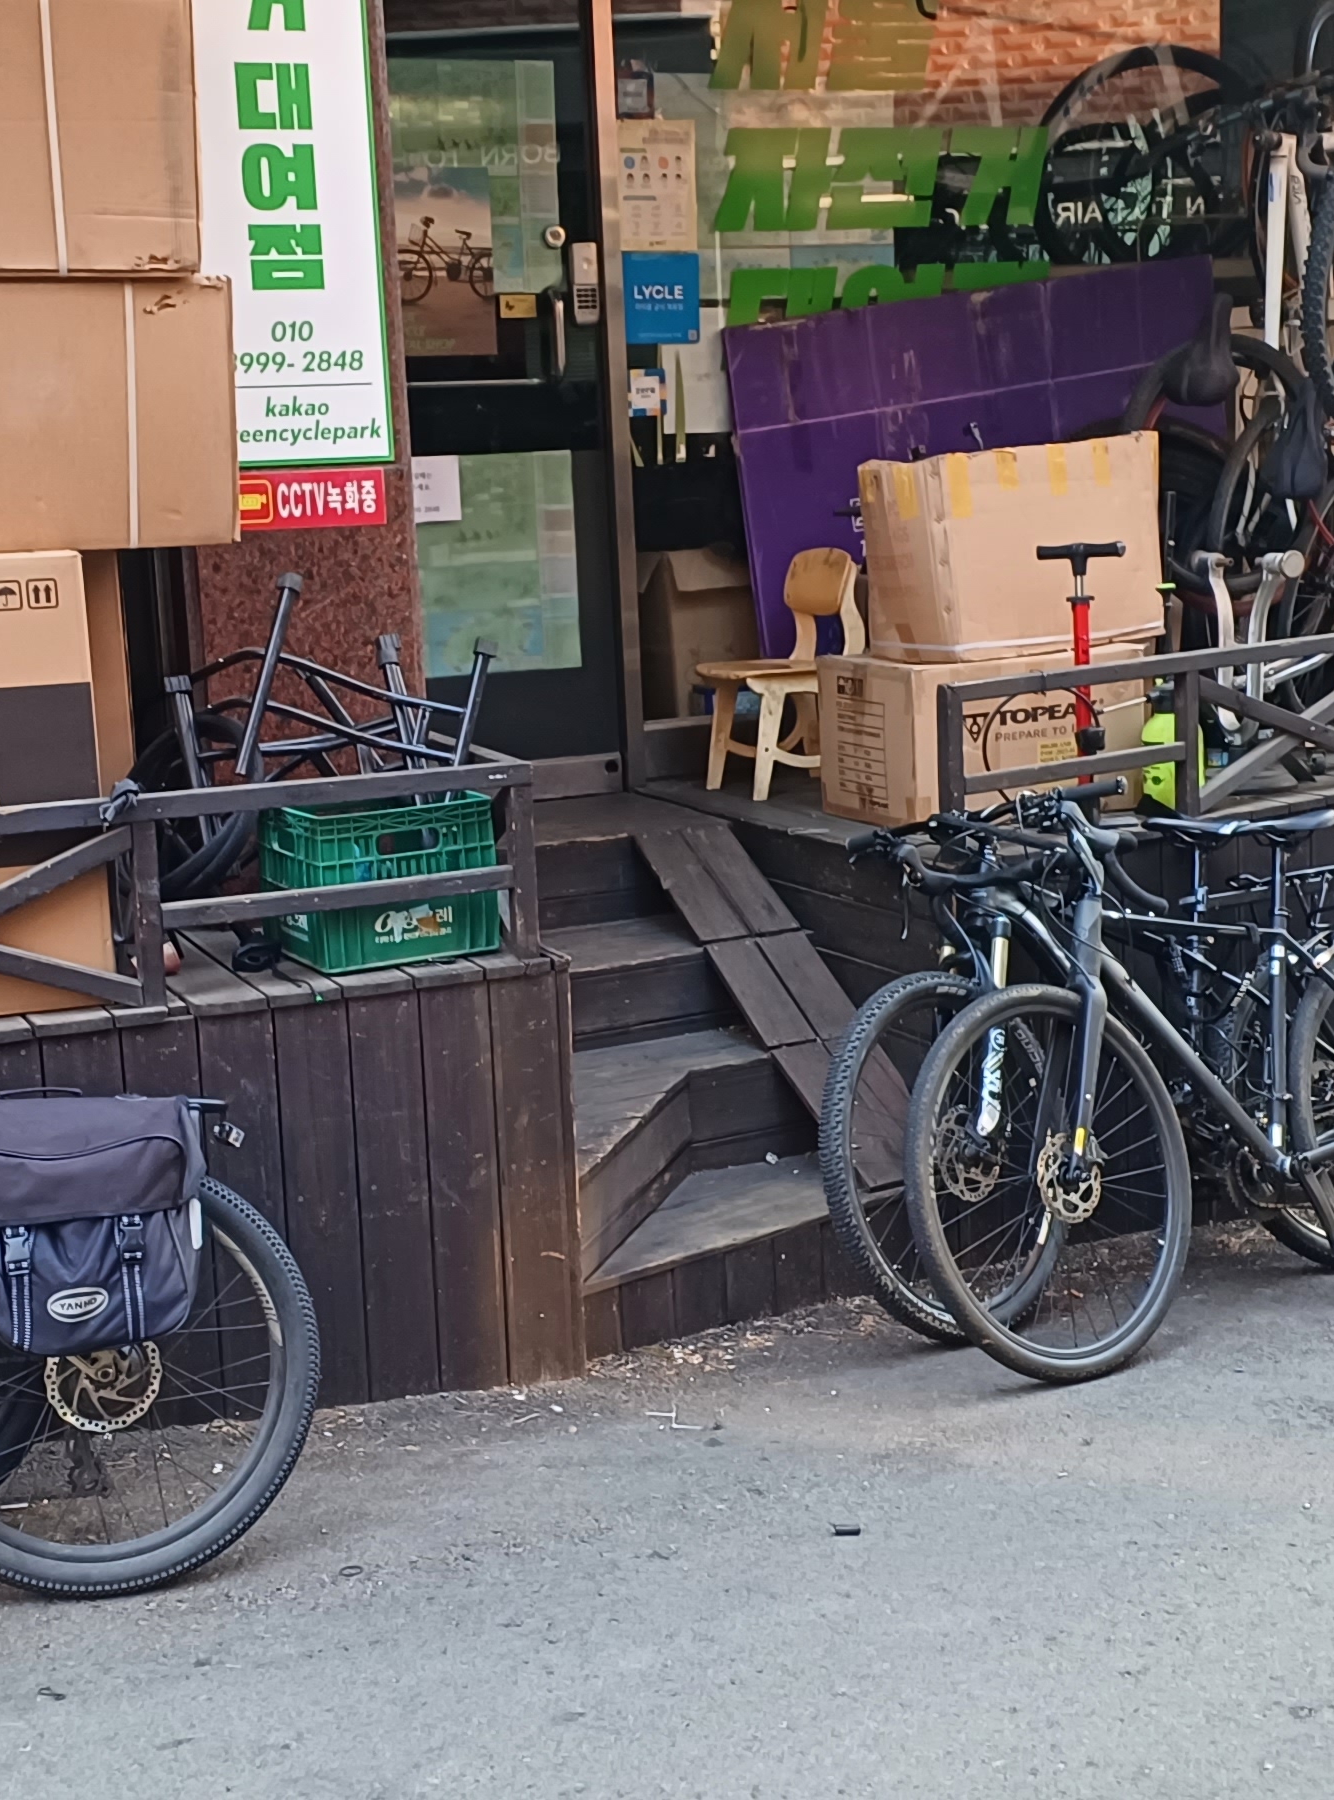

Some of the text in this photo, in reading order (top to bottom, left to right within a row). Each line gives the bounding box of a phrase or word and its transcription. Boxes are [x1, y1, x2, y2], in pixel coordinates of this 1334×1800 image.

[715, 126, 1049, 232] 자전거
[633, 285, 685, 300] LYCLE
[271, 320, 314, 342] 010
[302, 350, 364, 372] 2848
[265, 396, 330, 417] kakao
[237, 418, 382, 446] eencyclepark
[998, 699, 1097, 726] TOPEA
[995, 726, 1067, 742] PREPARE TO
